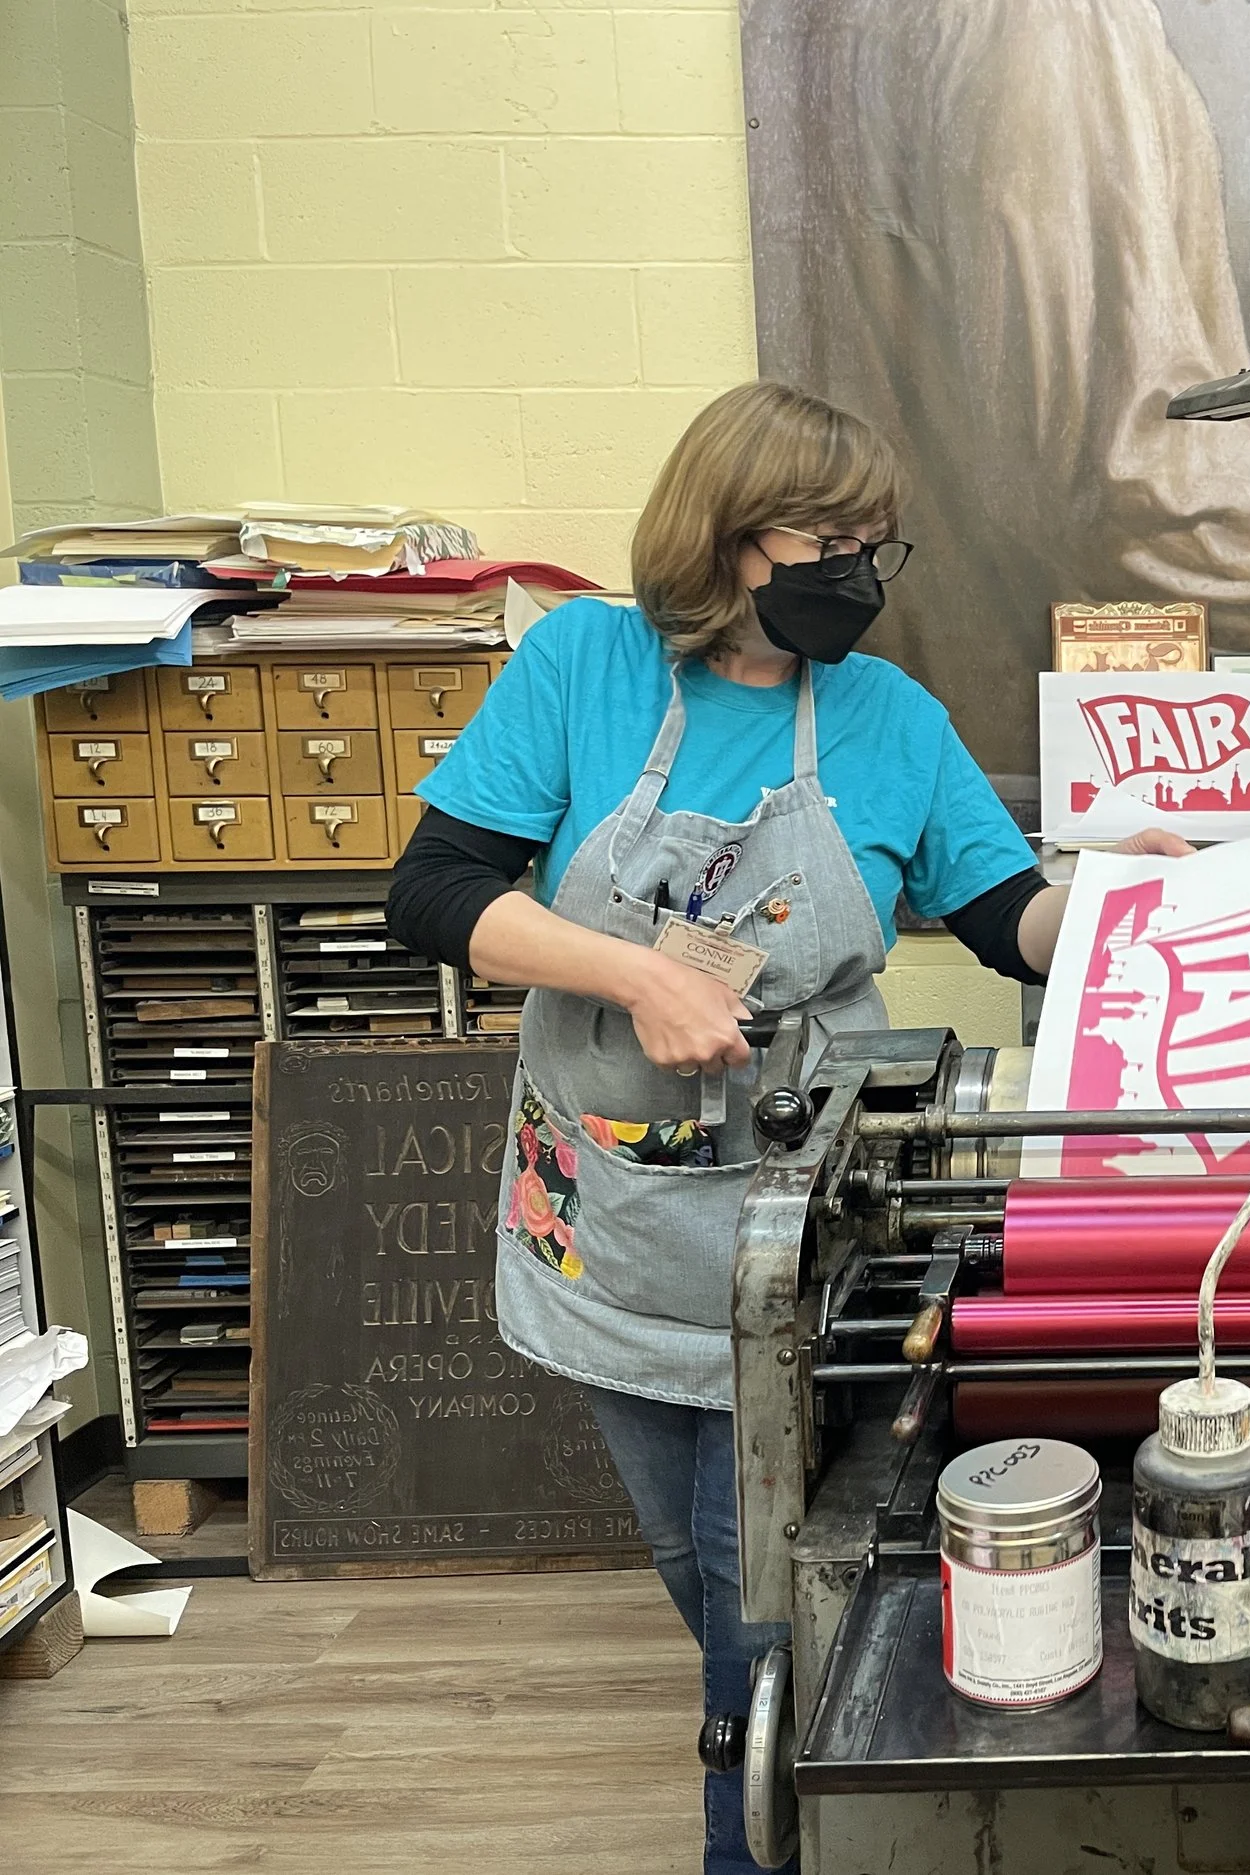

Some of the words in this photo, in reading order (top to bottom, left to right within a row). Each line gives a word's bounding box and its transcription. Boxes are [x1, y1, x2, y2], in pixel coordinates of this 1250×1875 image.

[198, 677, 216, 689] 24
[311, 674, 327, 684] 48
[1094, 702, 1241, 775] FAIR
[89, 743, 101, 754] 12
[205, 742, 217, 752] 18
[318, 742, 333, 753] 60
[323, 807, 337, 816] 72
[687, 943, 736, 965] CONNIE
